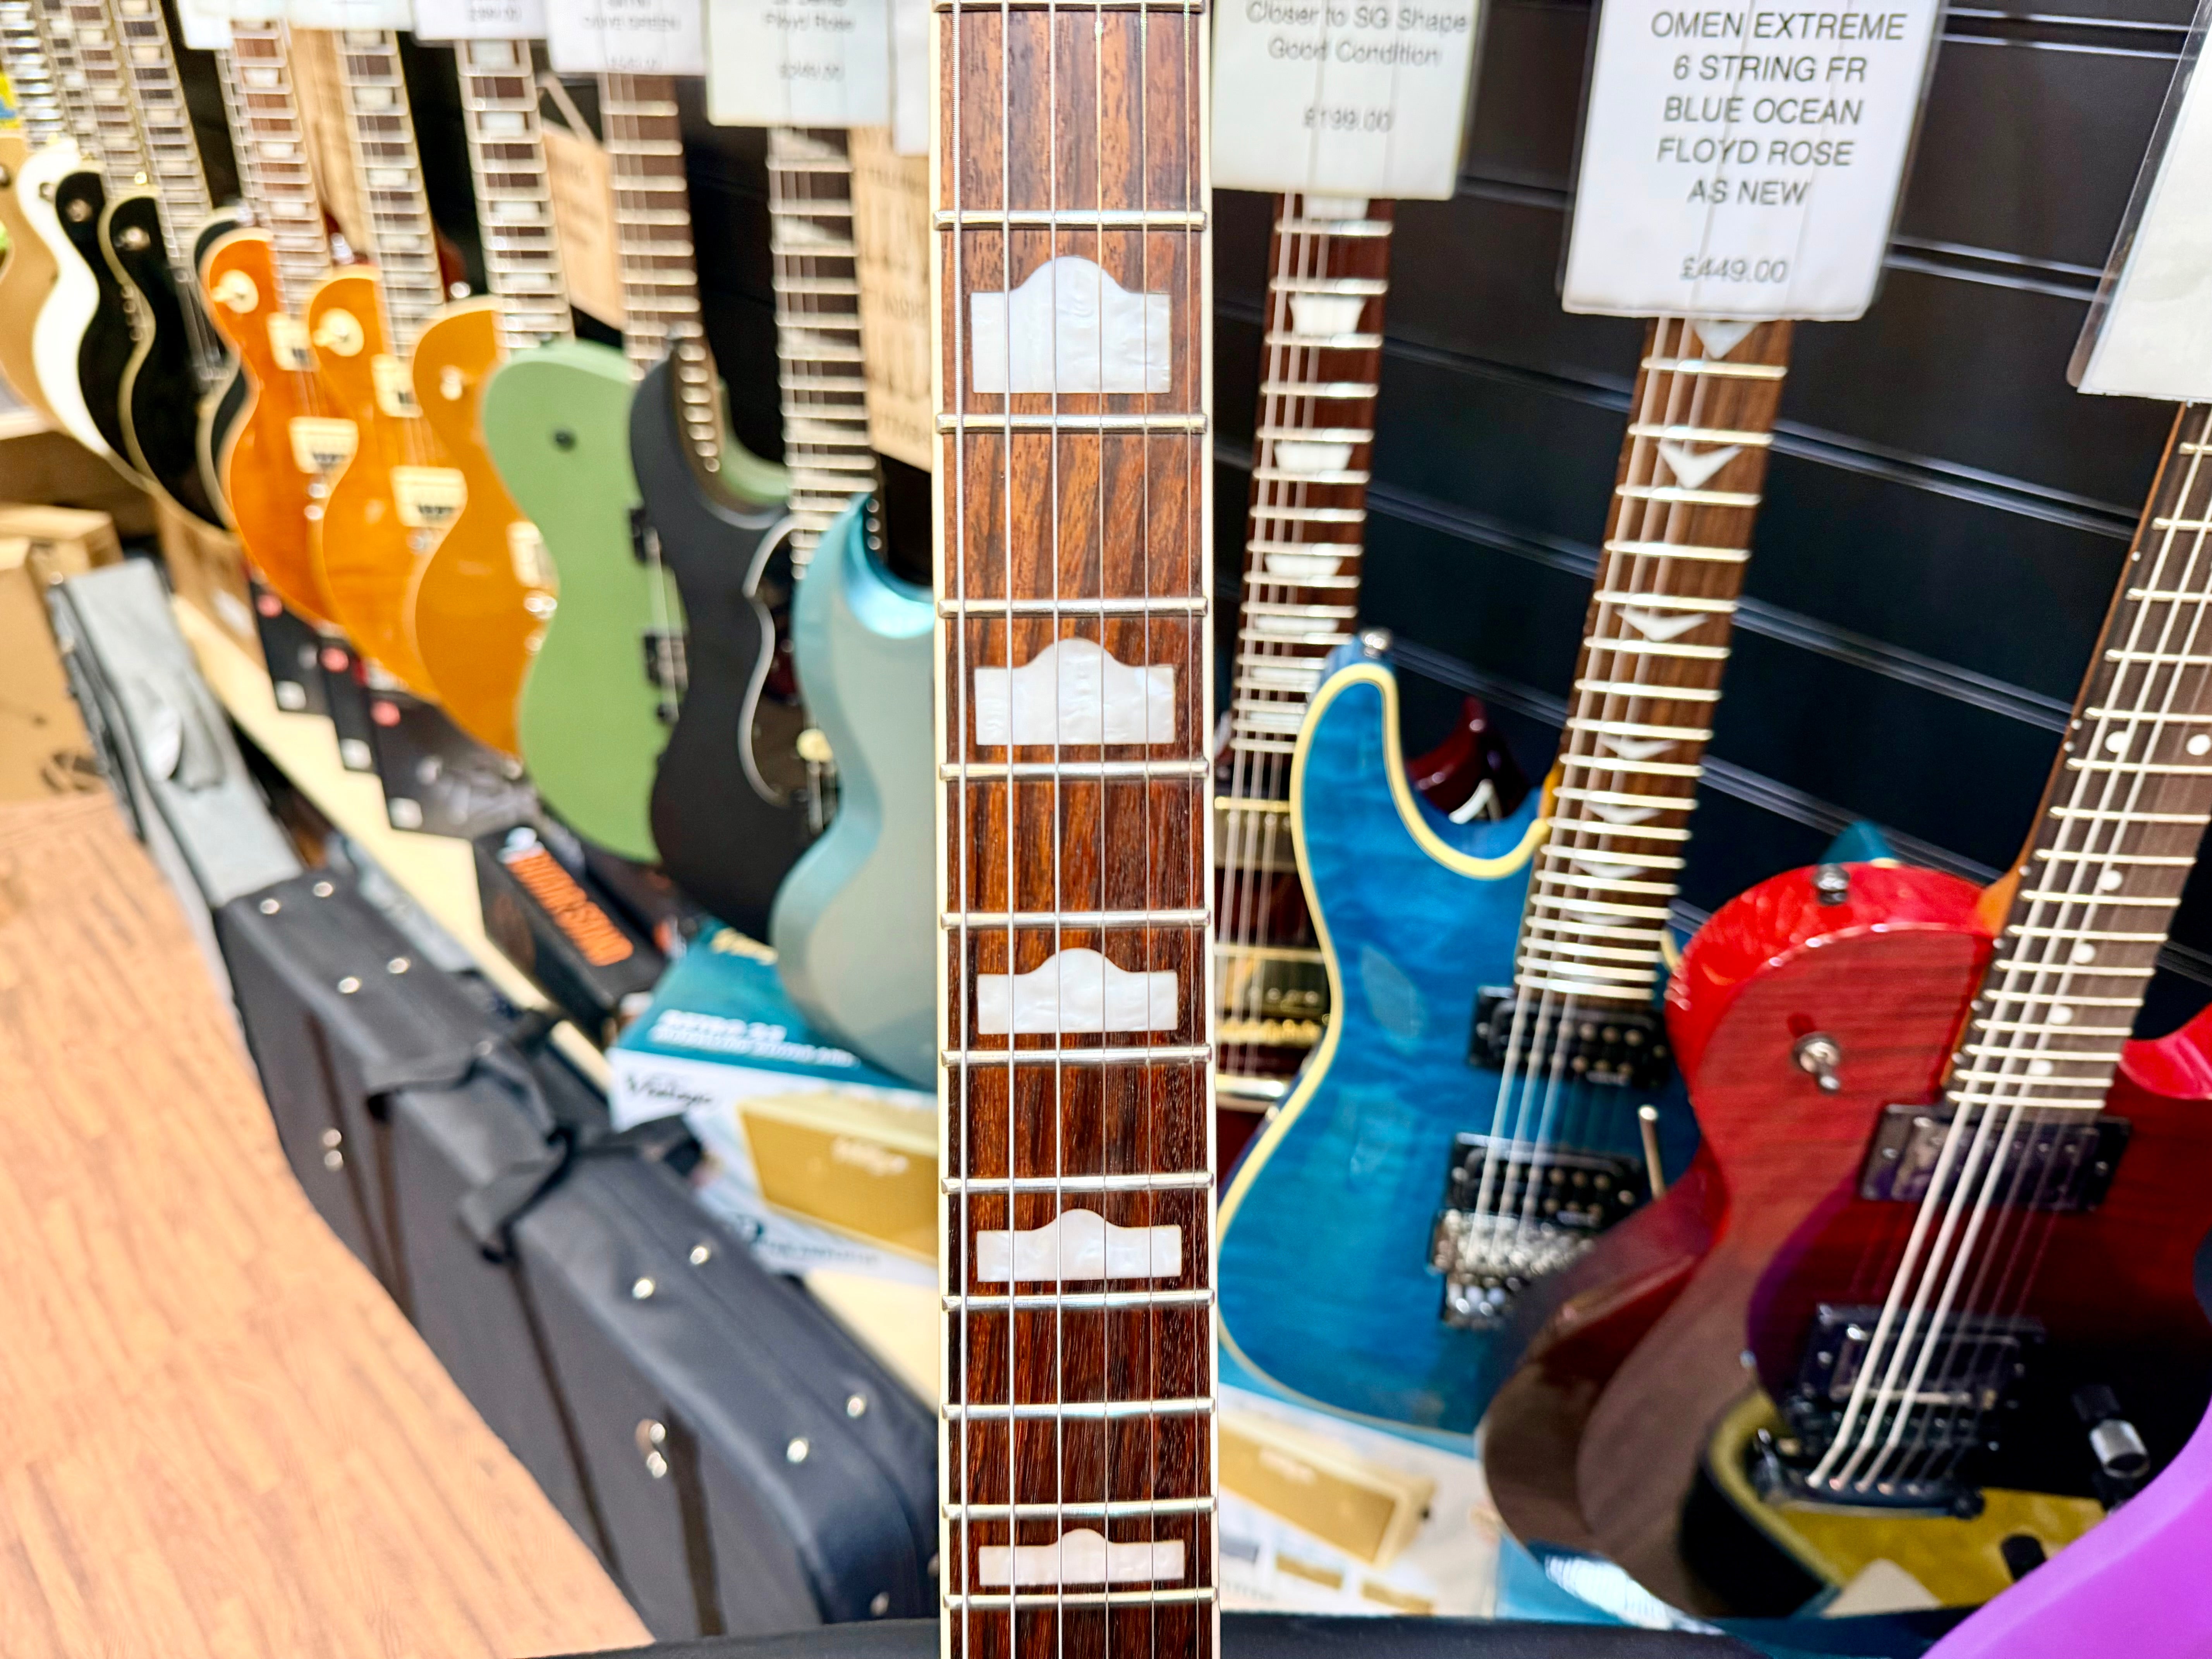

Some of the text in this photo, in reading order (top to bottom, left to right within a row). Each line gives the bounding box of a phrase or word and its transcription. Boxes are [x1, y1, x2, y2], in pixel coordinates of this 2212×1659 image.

[1246, 1, 1468, 36] Closer to SG Shape
[1651, 12, 1908, 40] OMEN EXTREME
[1267, 37, 1441, 66] Good Condition
[1673, 55, 1867, 82] 6 STRING FR
[1663, 96, 1863, 125] BLUE OCEAN
[1657, 139, 1855, 166] FLOYD ROSE
[1687, 179, 1811, 205] AS NEW
[1680, 256, 1788, 283] £449.00
